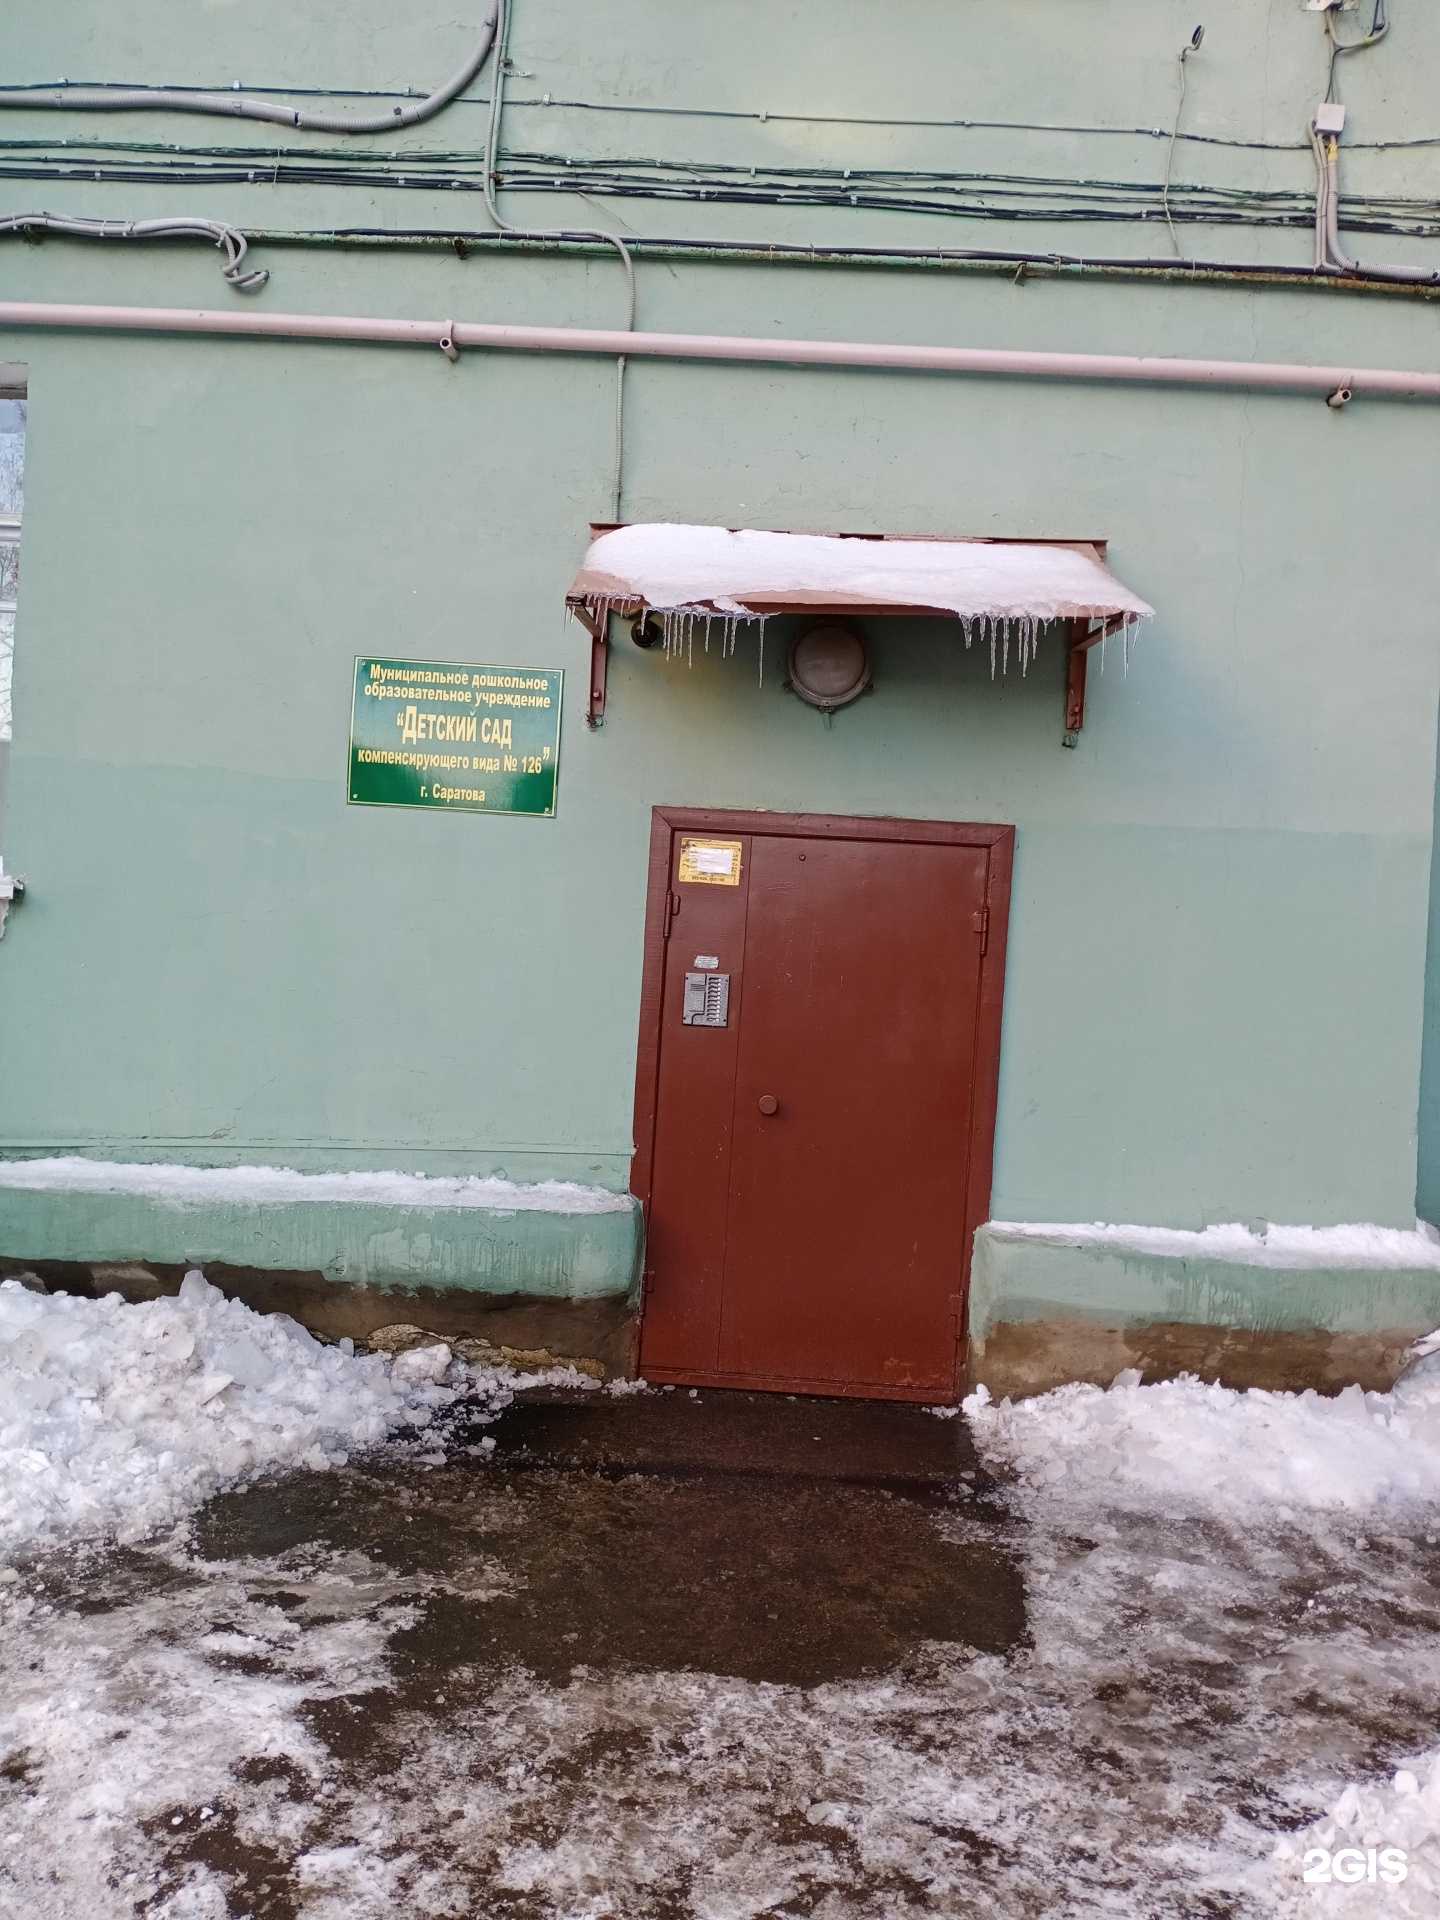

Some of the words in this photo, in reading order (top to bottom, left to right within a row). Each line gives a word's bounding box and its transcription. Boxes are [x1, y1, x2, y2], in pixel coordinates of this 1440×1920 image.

[370, 663, 469, 685] Муниципальное
[471, 673, 549, 690] дошкольное
[364, 682, 472, 703] образовательное
[475, 692, 551, 708] учреждение
[358, 749, 470, 771] компенсирующего
[472, 757, 500, 774] вида
[503, 754, 518, 772] №
[420, 785, 428, 798] г.
[432, 783, 486, 802] Саратова
